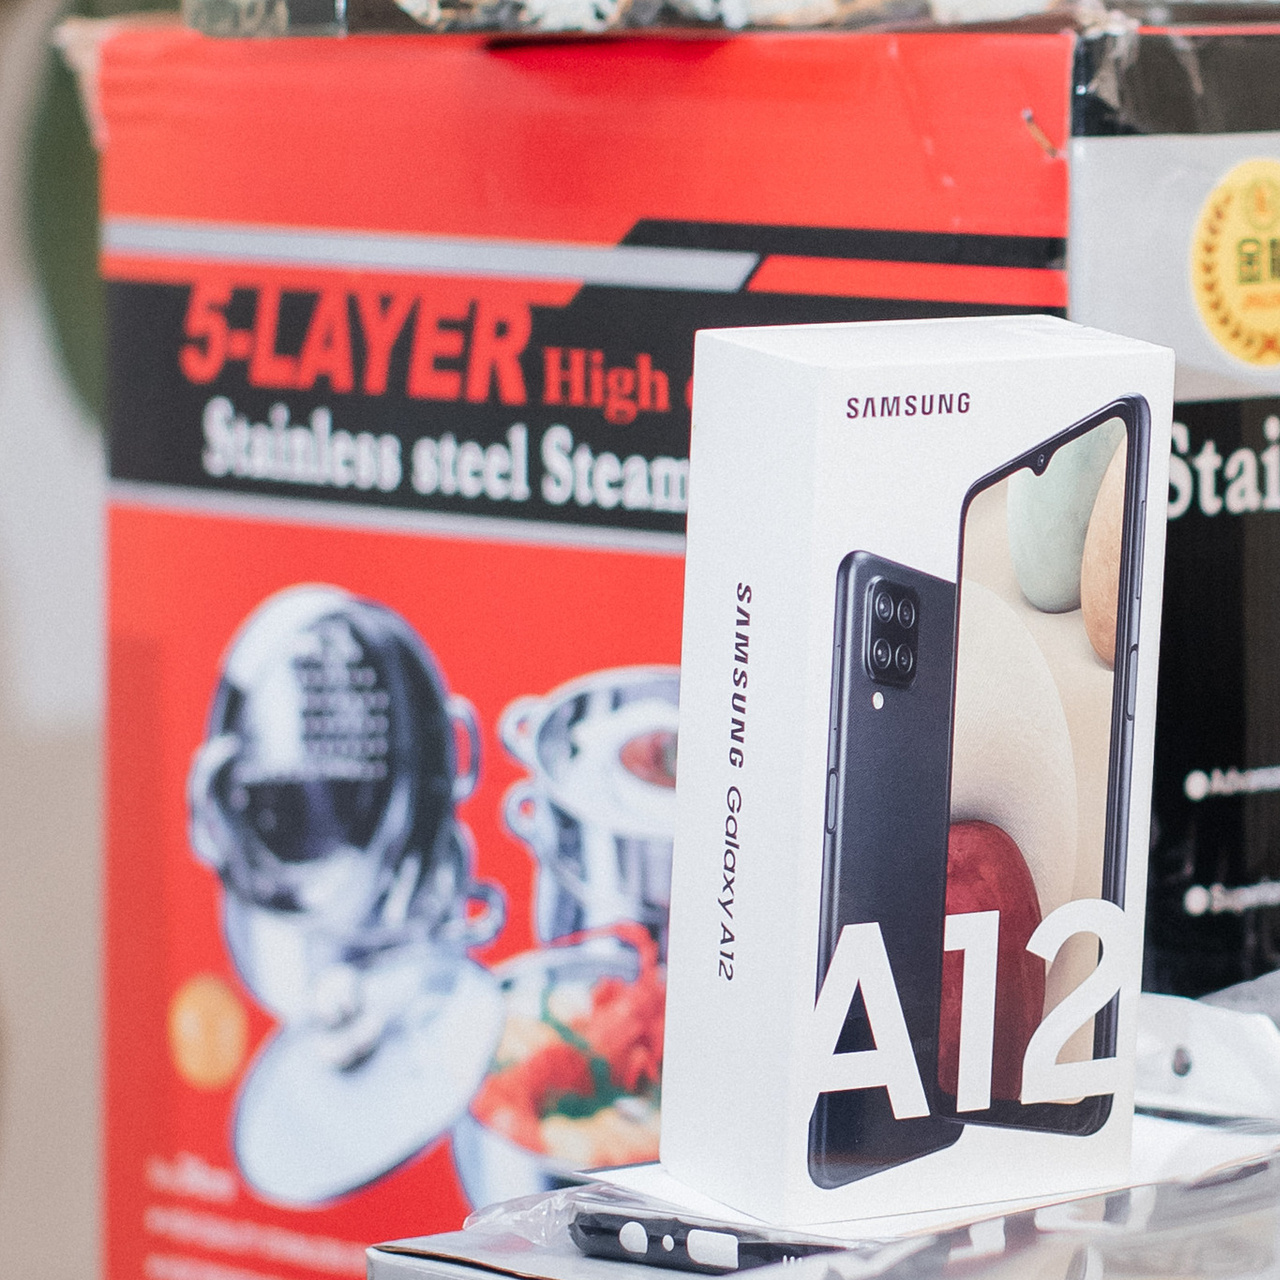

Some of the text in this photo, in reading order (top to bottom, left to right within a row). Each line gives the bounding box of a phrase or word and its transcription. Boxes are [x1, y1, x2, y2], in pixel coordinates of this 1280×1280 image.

[178, 278, 672, 425] 5-LAYER High
[845, 390, 972, 420] SAMSUNG
[202, 396, 402, 493] Stainless
[411, 422, 530, 503] steel
[717, 581, 753, 983] SAMSUNG Galaxy A12
[808, 898, 1123, 1122] A12
